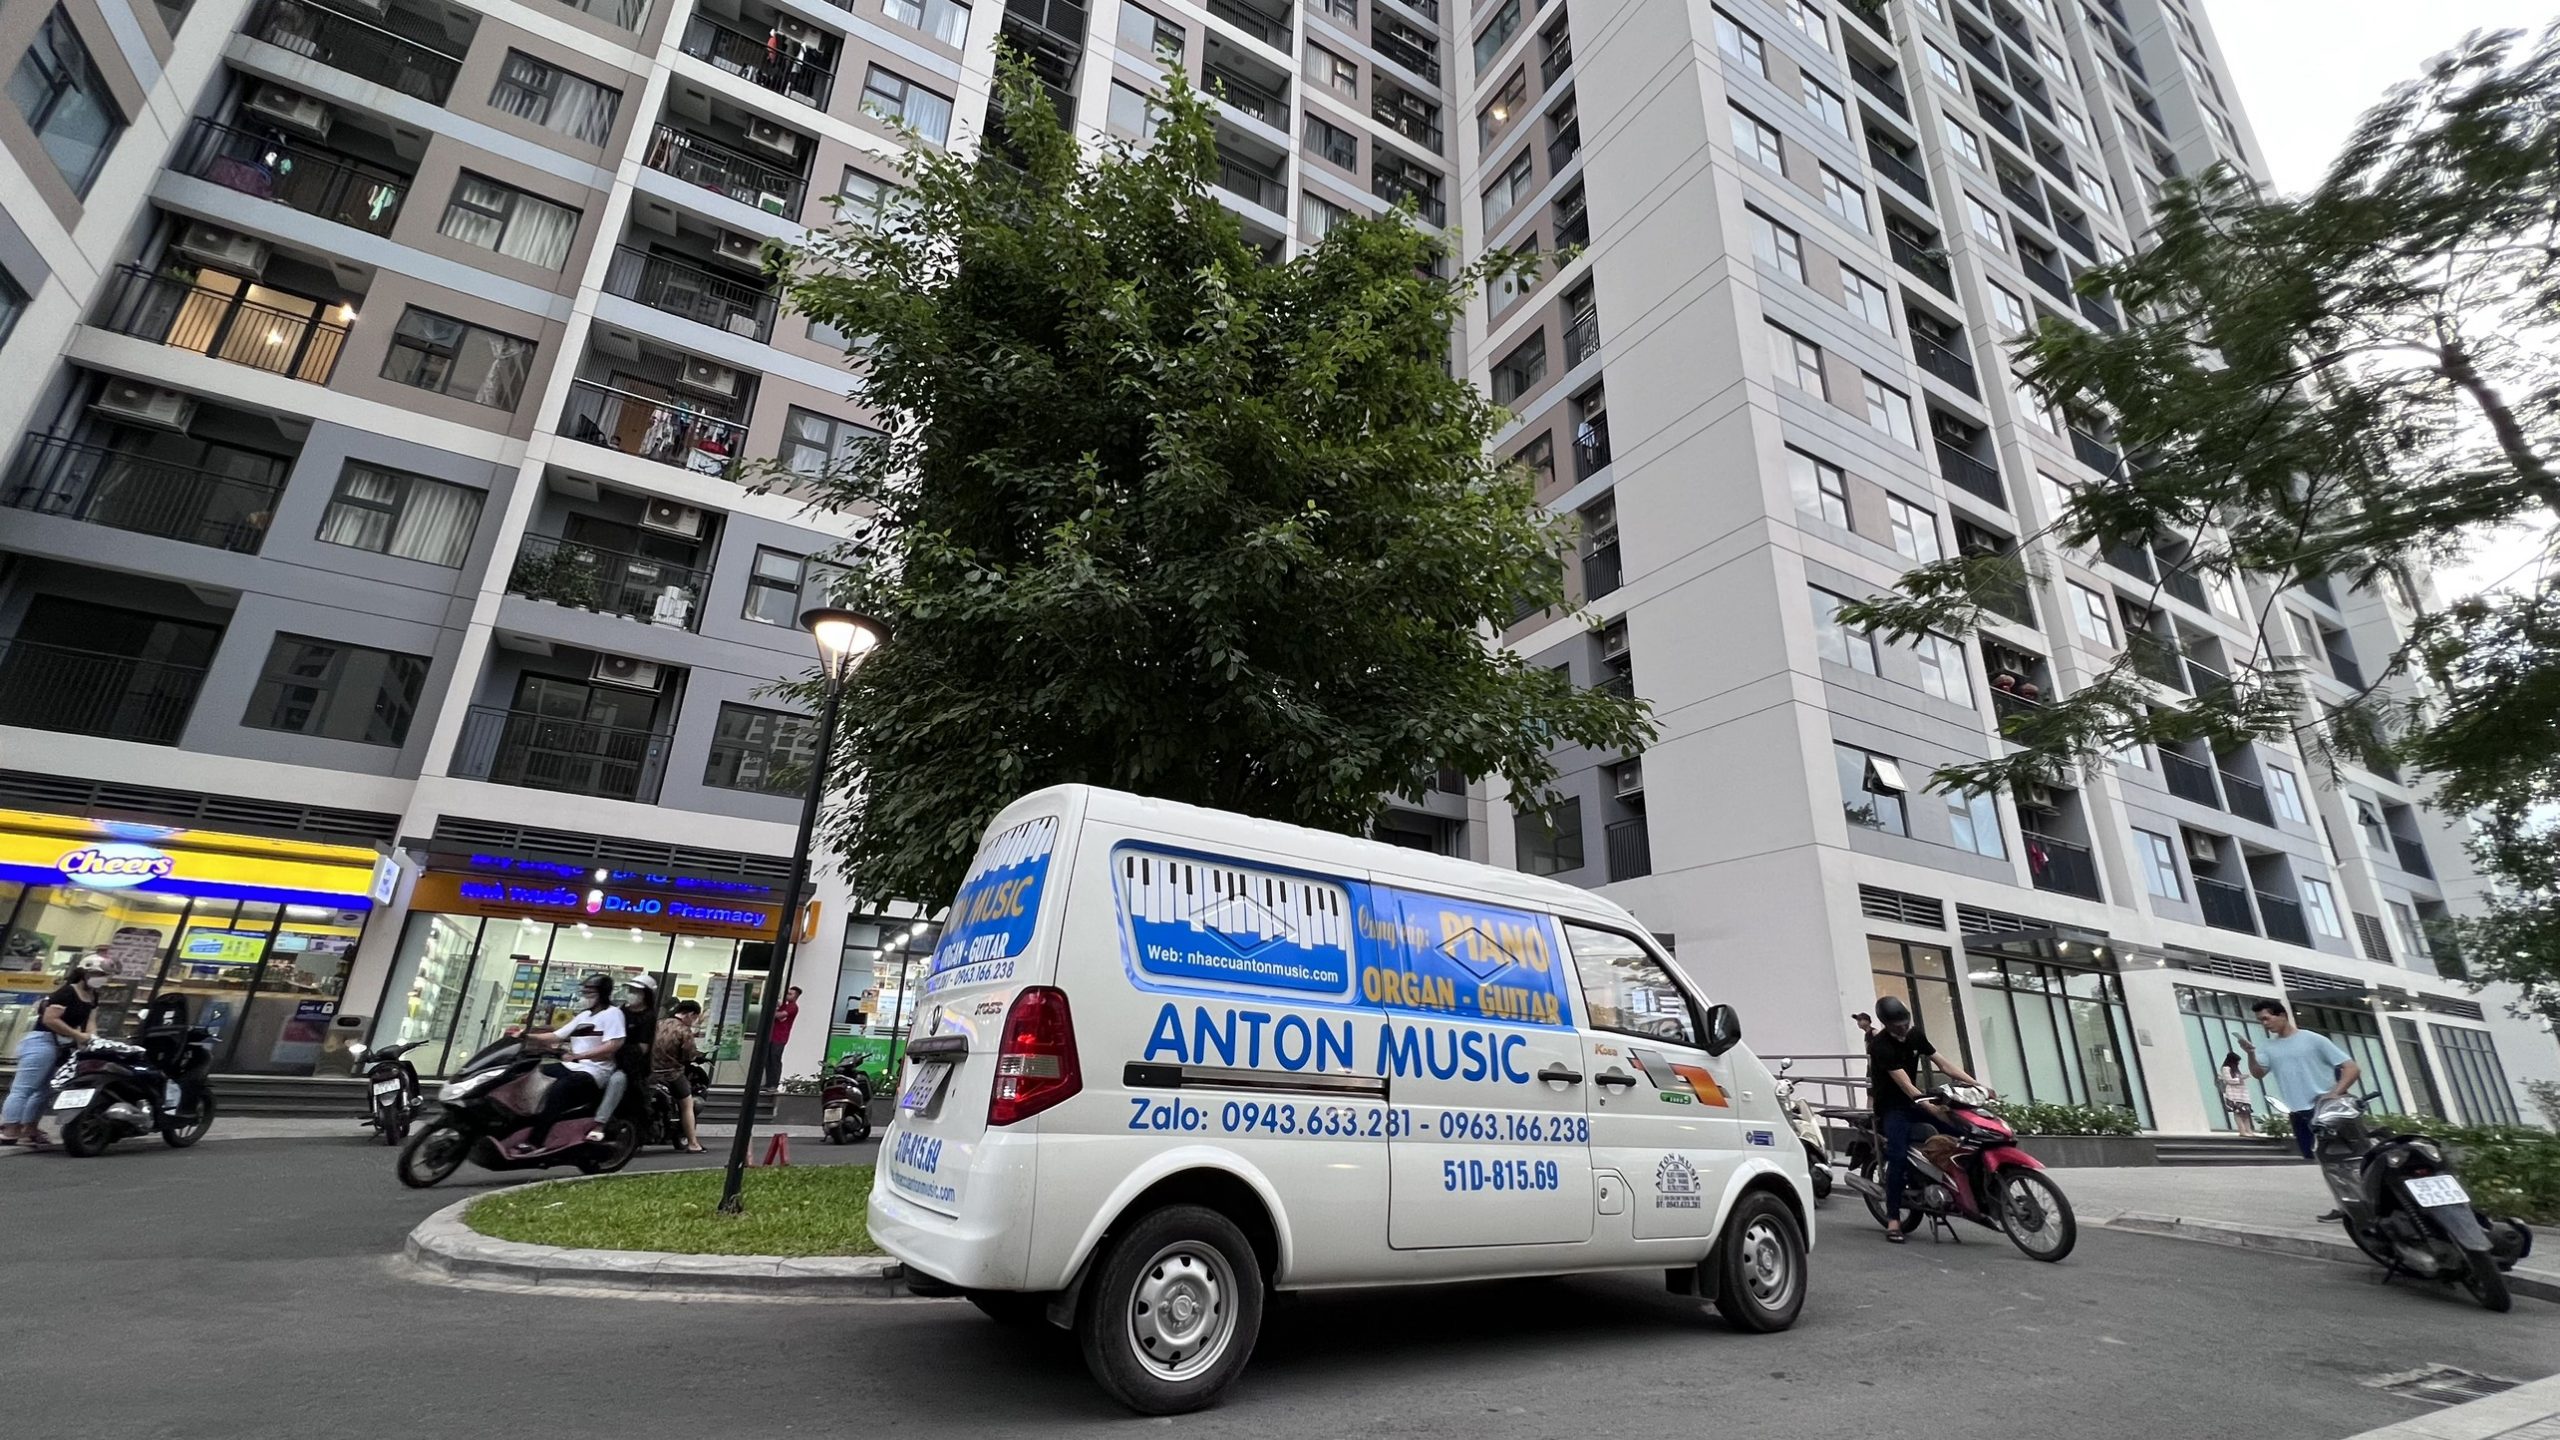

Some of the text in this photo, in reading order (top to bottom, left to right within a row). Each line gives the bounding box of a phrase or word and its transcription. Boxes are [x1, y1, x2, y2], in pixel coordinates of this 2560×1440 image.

[57, 849, 173, 875] Cheers
[668, 902, 767, 927] Pharmacy
[966, 876, 1033, 925] MUSIC
[969, 932, 1010, 962] GUITAR
[1439, 911, 1548, 973] PIANO
[1147, 944, 1339, 983] Web: nhaccuantonmusic.com
[1363, 966, 1456, 1011] ORGAN
[1477, 985, 1562, 1026] GUITAR
[1144, 1002, 1530, 1084] ANTON MUSIC
[1128, 1097, 1208, 1131] Zalo:
[1222, 1101, 1410, 1137] 0943.633.281
[1440, 1111, 1589, 1142] 0963.166.238
[1443, 1160, 1559, 1191] 51D-815.69
